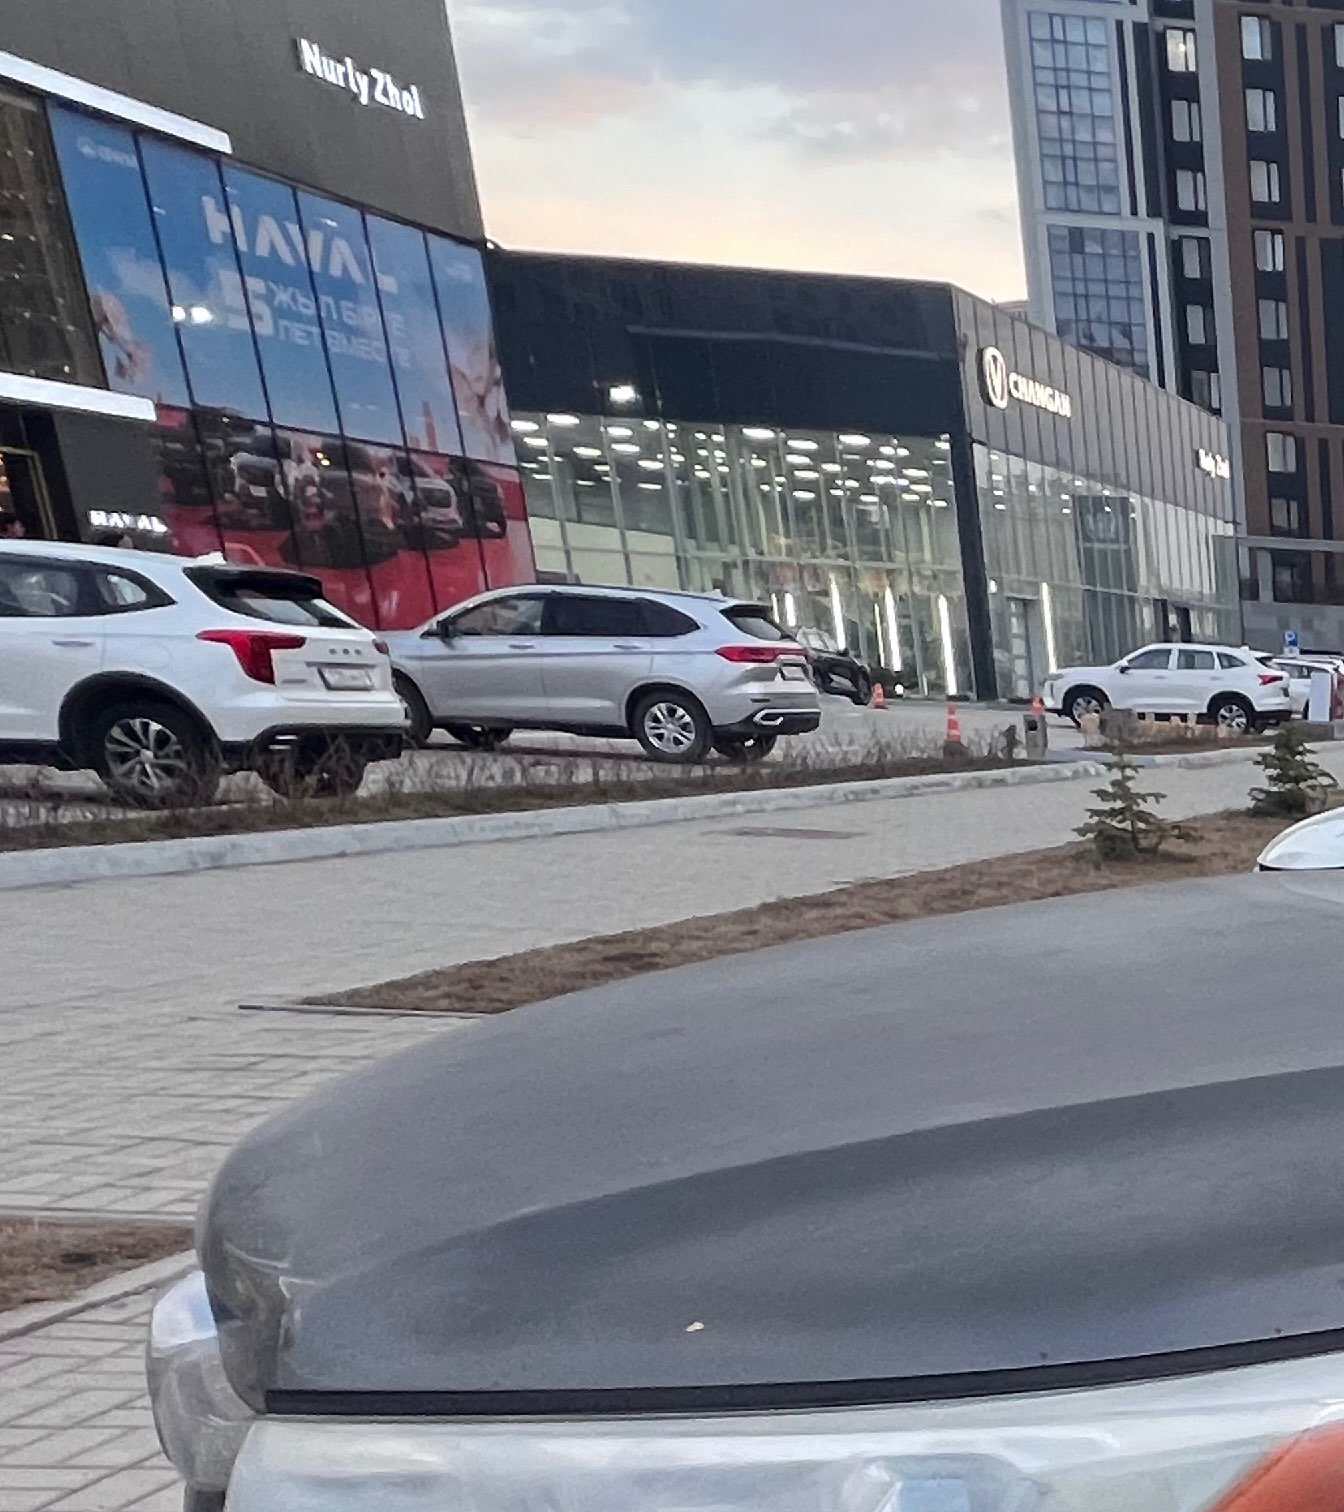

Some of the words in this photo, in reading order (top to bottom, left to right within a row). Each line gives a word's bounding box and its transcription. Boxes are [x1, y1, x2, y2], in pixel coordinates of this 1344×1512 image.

[300, 37, 369, 105] Nurly
[370, 67, 425, 119] Zhol
[202, 196, 398, 294] HAVAL
[218, 269, 274, 337] 5
